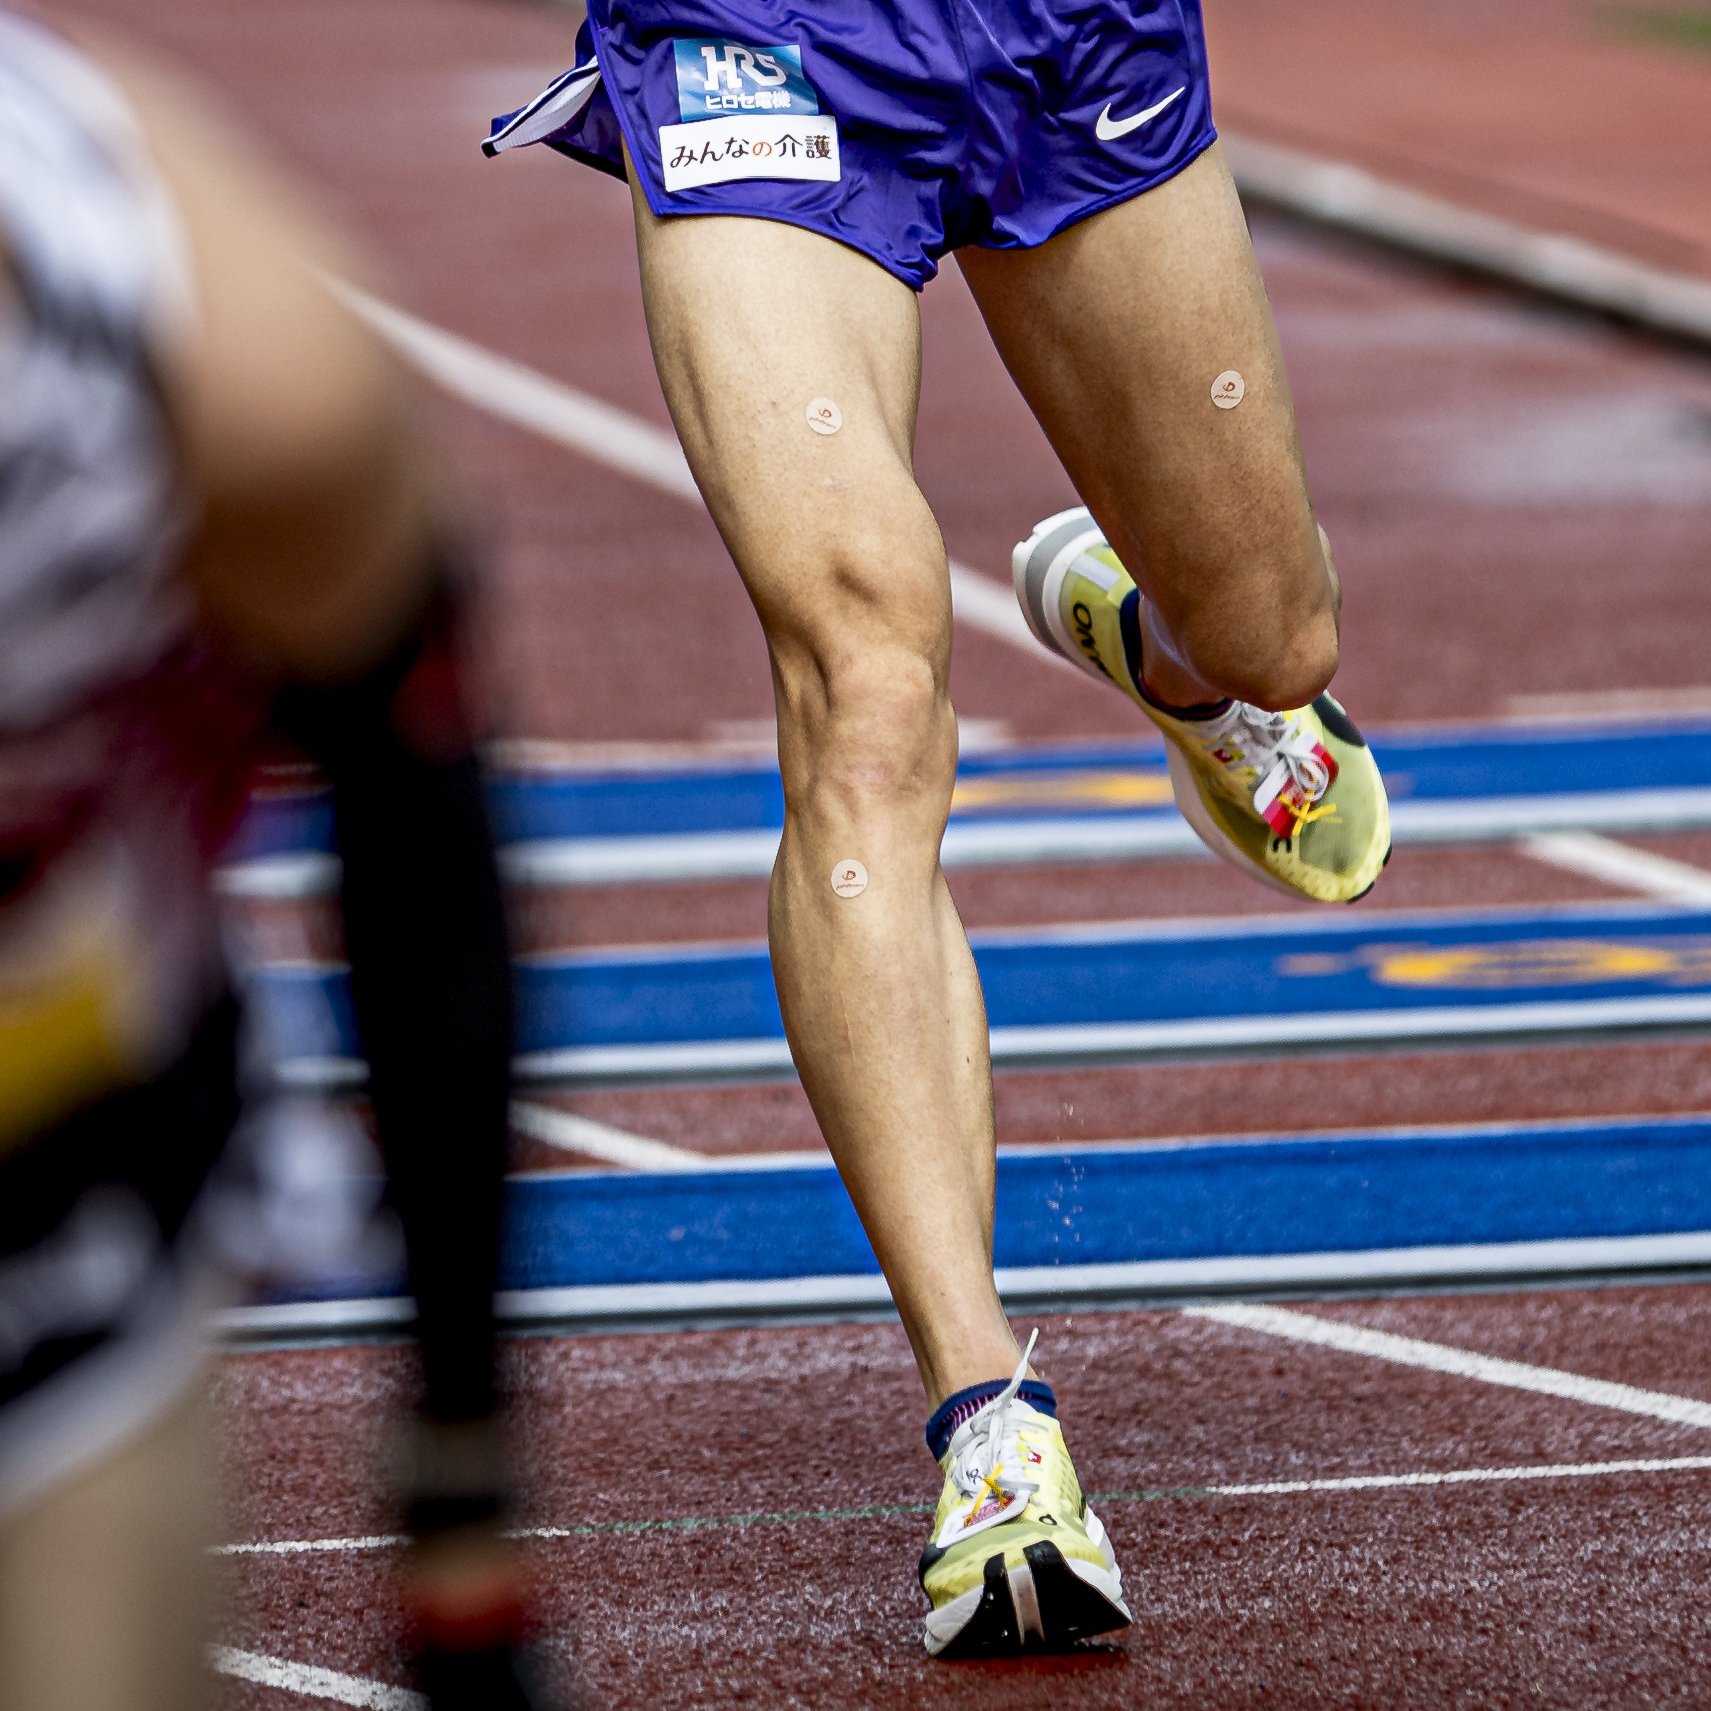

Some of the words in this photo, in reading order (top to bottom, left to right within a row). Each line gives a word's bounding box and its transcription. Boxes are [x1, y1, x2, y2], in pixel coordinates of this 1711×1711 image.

[700, 45, 787, 91] HRS
[704, 90, 792, 110] ヒロセ電機
[669, 133, 833, 168] みんなの介護
